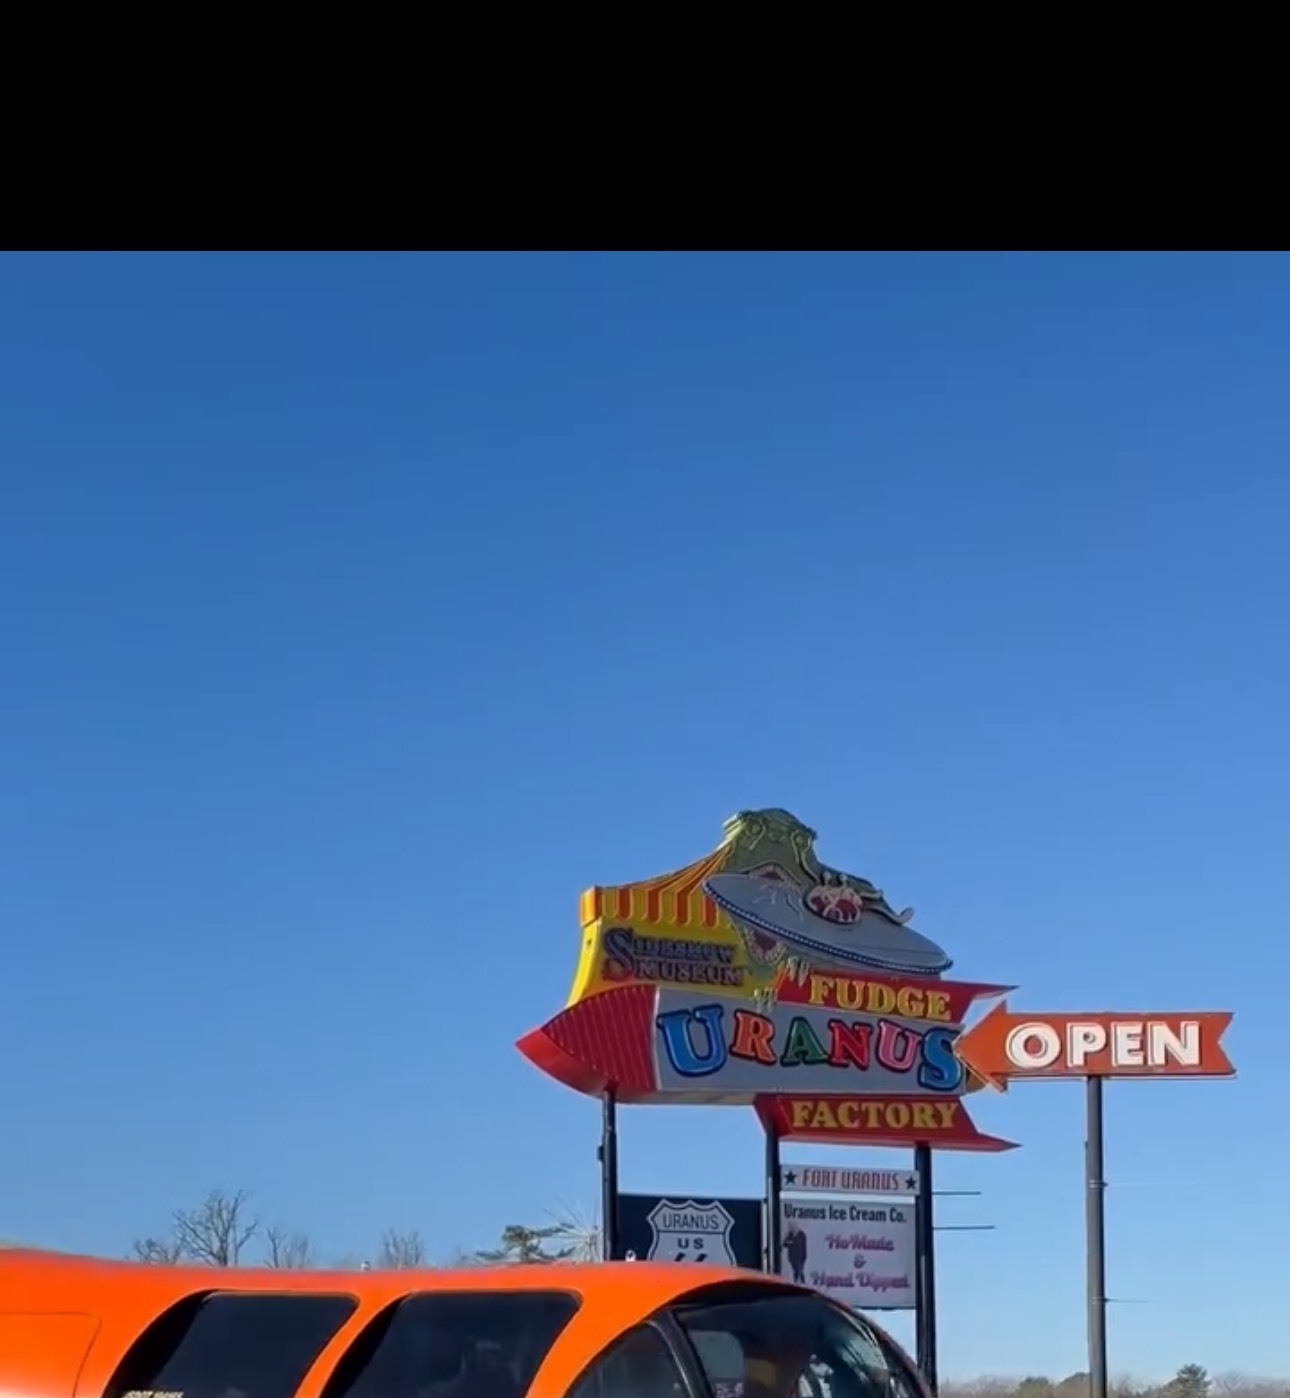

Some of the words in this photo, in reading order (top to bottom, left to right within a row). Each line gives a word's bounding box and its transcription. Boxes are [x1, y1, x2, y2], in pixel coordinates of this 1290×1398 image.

[634, 958, 744, 986] MUSEUM
[808, 973, 951, 1020] FUDGE
[656, 1003, 964, 1091] URANUS
[1005, 1020, 1201, 1069] OPEN
[792, 1101, 959, 1129] FACTORY
[802, 1169, 837, 1188] FORT
[841, 1171, 899, 1191] URANUS
[662, 1213, 719, 1230] URANUS
[784, 1203, 826, 1220] Uranus
[829, 1205, 847, 1220] Ice
[849, 1206, 887, 1222] Cream
[889, 1207, 907, 1223] Co.
[677, 1237, 704, 1250] US
[854, 1254, 867, 1269] &
[811, 1271, 855, 1288] Hand
[856, 1272, 910, 1292] Dipped
